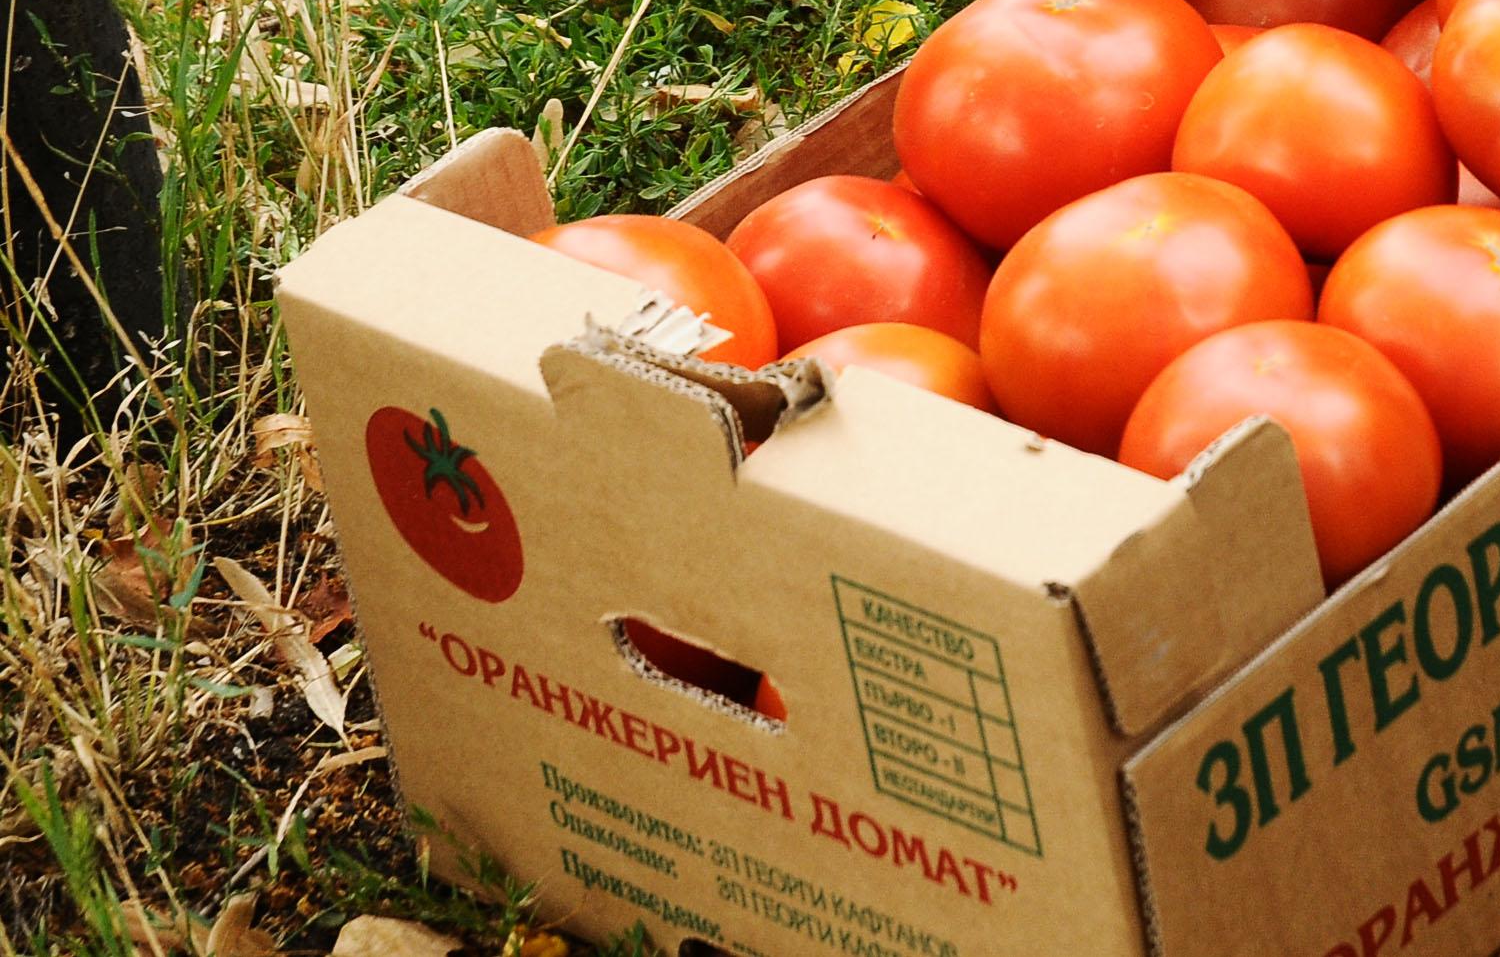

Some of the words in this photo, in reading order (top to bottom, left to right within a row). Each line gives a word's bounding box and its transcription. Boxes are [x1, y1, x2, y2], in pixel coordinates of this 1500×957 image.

[854, 635, 928, 681] ЕКСТРА
[862, 596, 975, 661] КАЧЕСТВО
[873, 722, 938, 765] ВТОРО
[1195, 685, 1313, 863] ЗП
[540, 760, 704, 857] Производител:
[744, 854, 827, 911] ГЕОРГИ
[549, 800, 678, 879] Опаковано:
[751, 889, 835, 947] ГЕОРГИ
